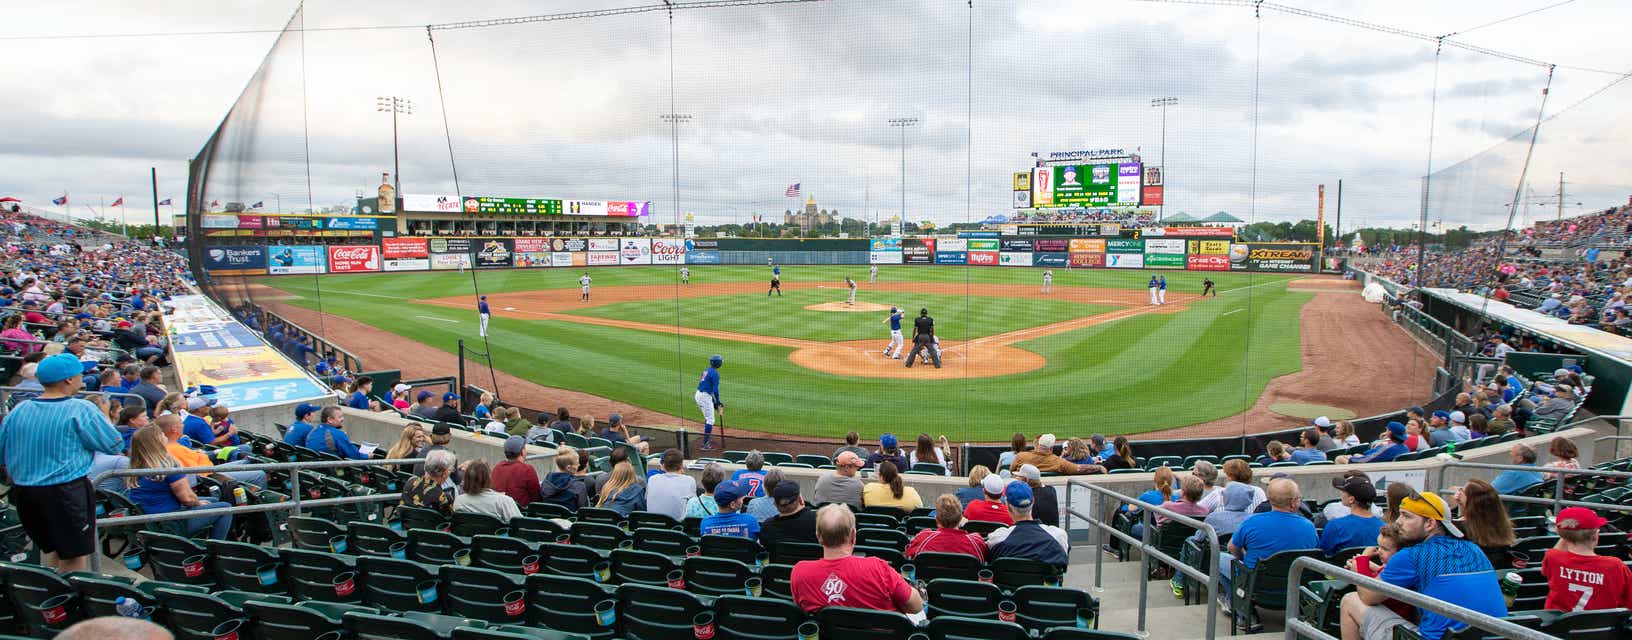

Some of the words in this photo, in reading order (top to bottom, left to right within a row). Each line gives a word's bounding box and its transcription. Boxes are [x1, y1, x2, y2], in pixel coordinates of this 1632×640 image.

[1050, 150, 1098, 158] PRINCIPAL
[653, 241, 685, 255] Coors
[748, 479, 760, 497] 7
[1560, 566, 1605, 585] LYTTON
[825, 579, 843, 596] 90
[1568, 583, 1594, 612] 7
